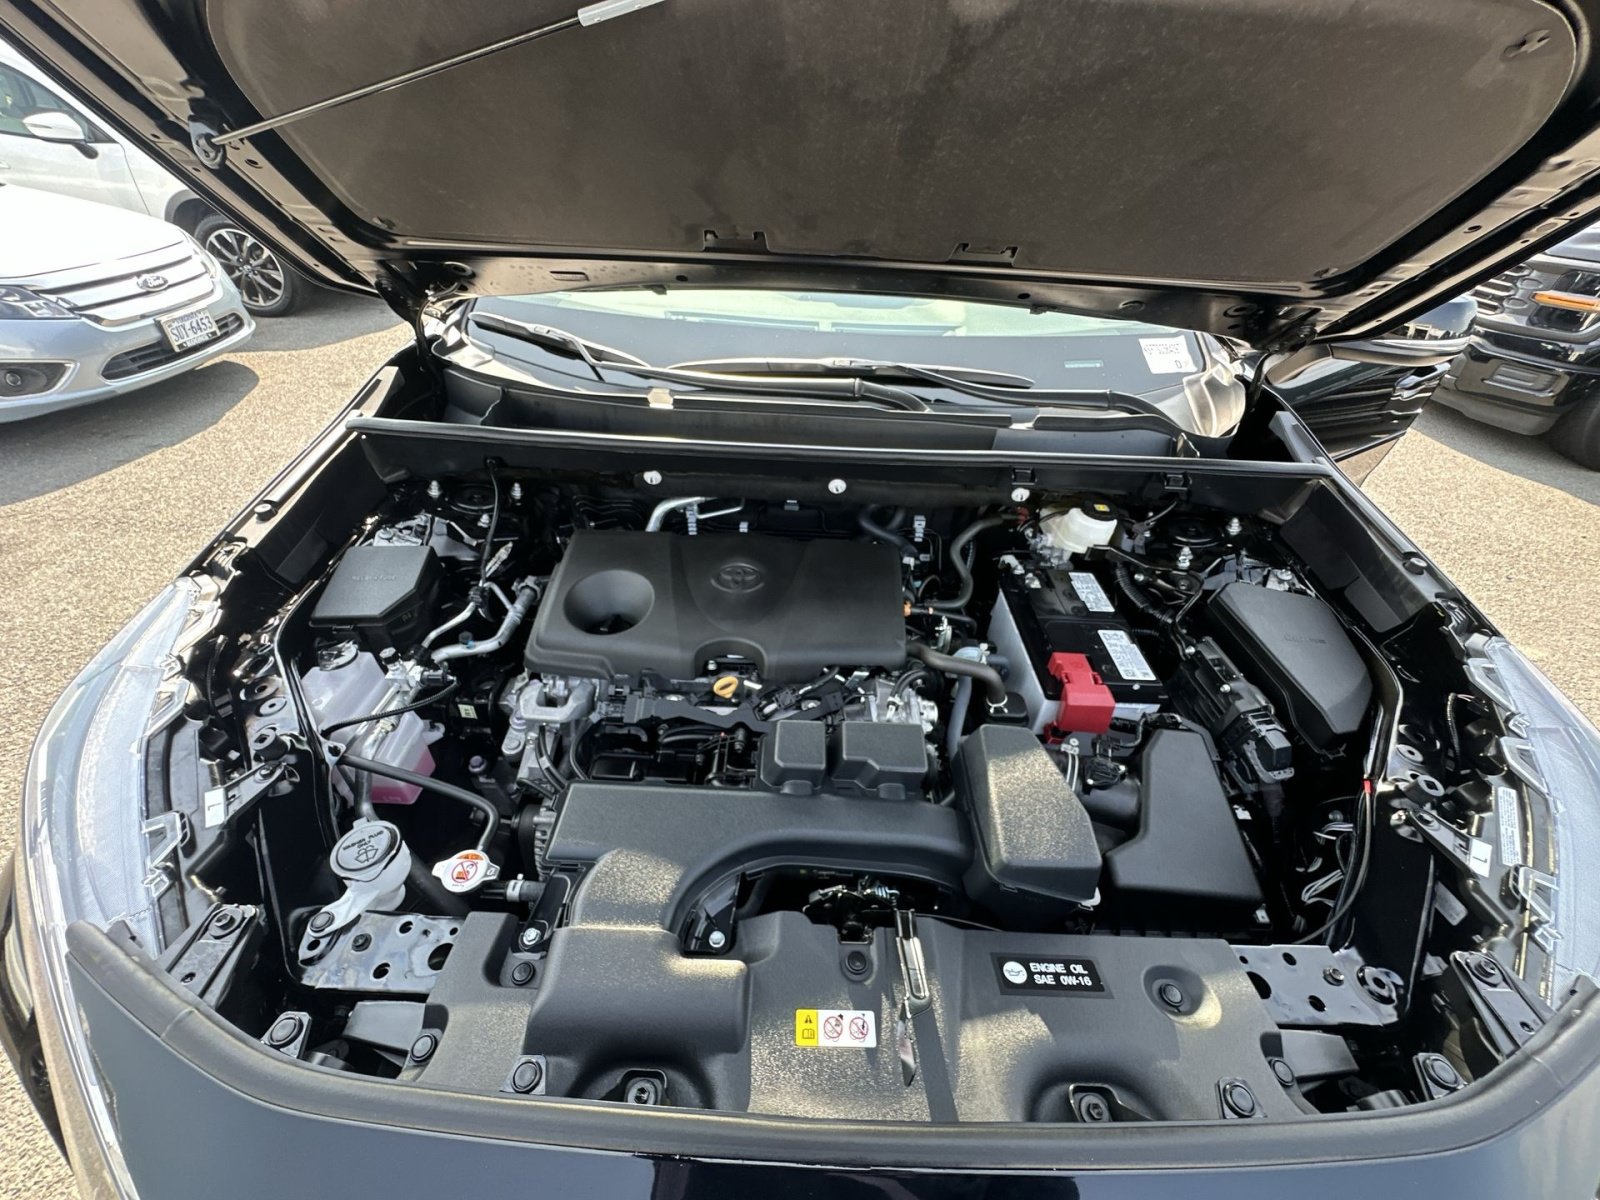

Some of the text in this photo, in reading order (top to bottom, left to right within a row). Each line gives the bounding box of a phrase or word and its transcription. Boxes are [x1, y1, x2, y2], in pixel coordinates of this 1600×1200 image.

[170, 316, 214, 342] SUY-6453
[1029, 962, 1088, 974] ENGINE OIL
[1034, 974, 1056, 985] SAE
